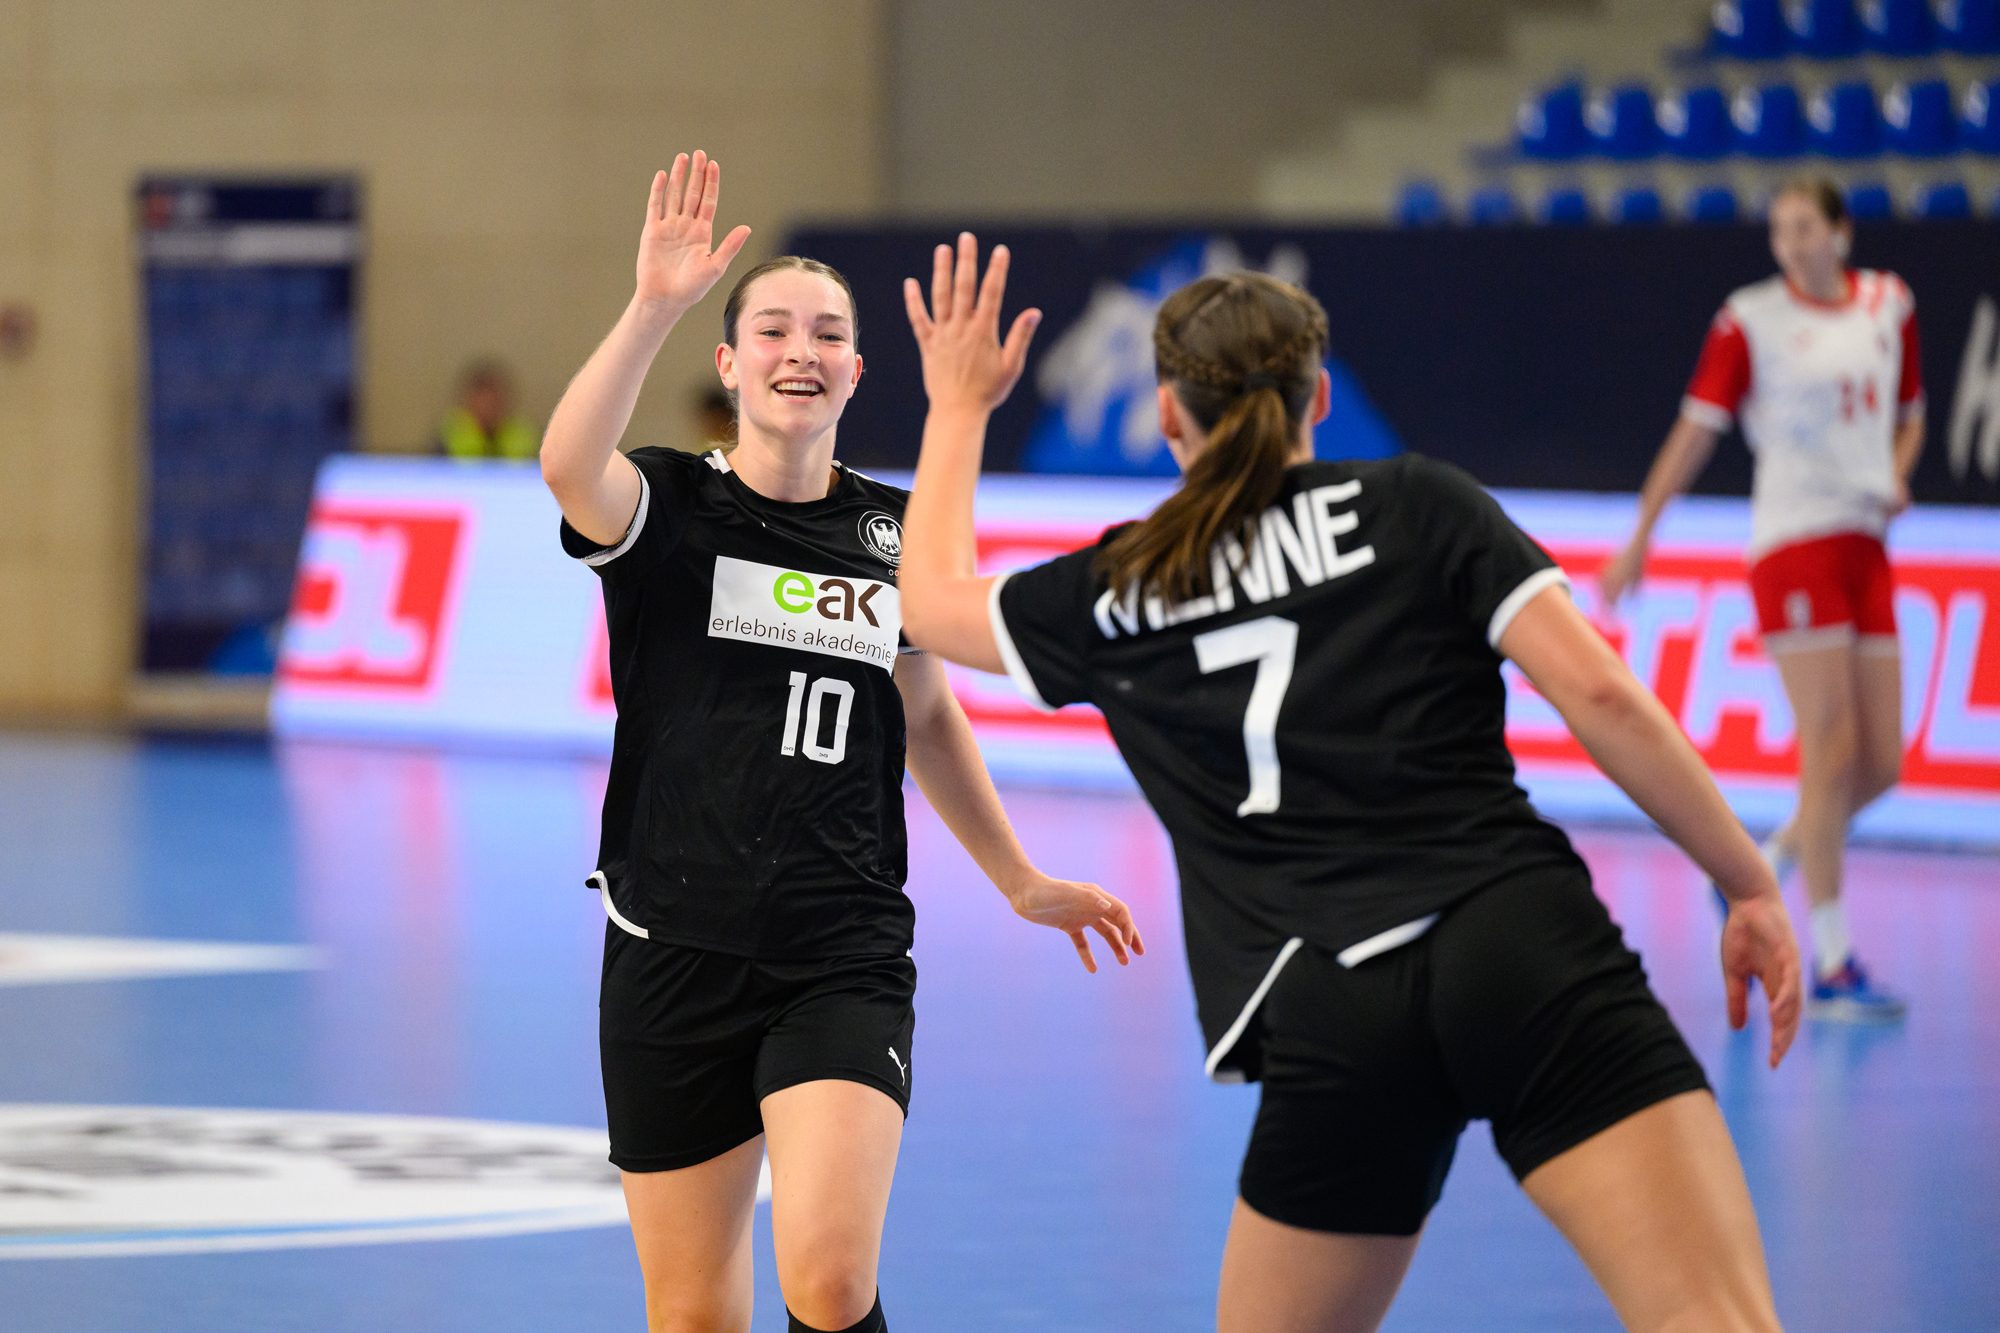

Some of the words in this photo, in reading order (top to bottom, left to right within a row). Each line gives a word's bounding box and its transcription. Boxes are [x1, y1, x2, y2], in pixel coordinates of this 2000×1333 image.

[773, 571, 884, 629] eak
[711, 615, 797, 643] erlebnis
[803, 628, 892, 664] akademie
[780, 670, 856, 765] 10
[1193, 615, 1299, 818] 7
